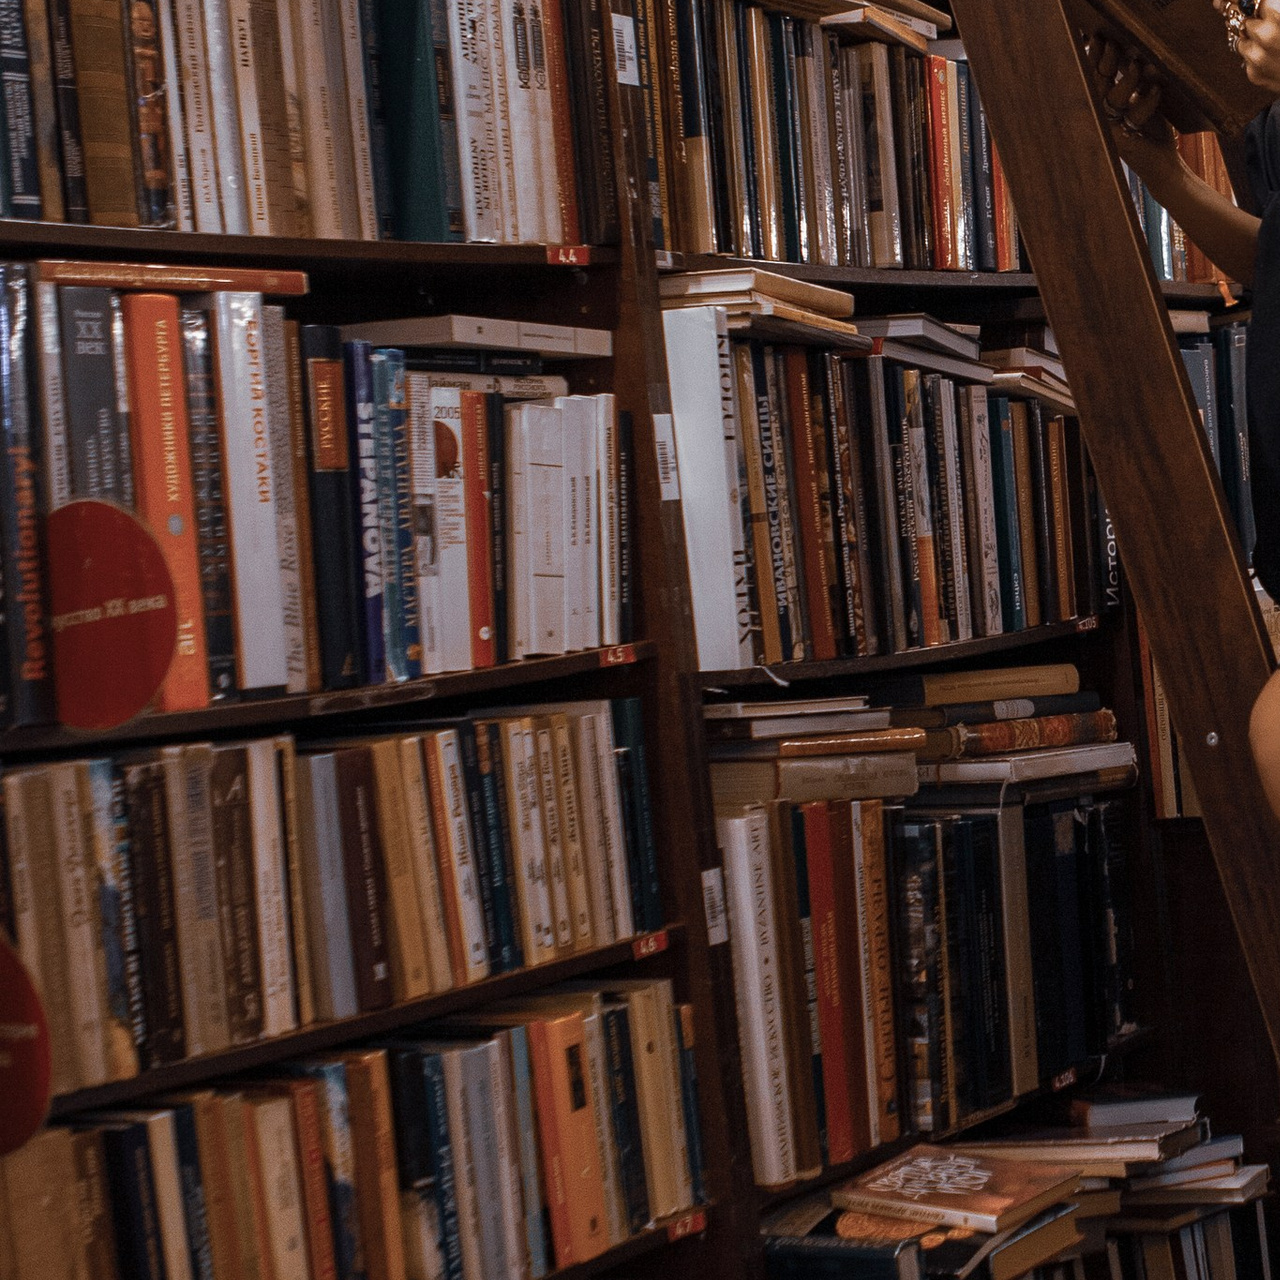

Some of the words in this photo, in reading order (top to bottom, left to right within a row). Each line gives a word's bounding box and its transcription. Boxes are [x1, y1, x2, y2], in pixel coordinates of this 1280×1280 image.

[236, 16, 250, 68] НАРБУТ
[188, 54, 205, 133] Голландский
[830, 68, 842, 108] TRAYS
[484, 120, 496, 162] АНРИ
[501, 126, 513, 170] АНРИ
[978, 113, 991, 173] Драгоценные
[477, 149, 489, 191] COLOR
[983, 185, 993, 208] Смит
[558, 249, 577, 263] 4.4
[150, 318, 173, 407] ПЕТЕРБУРГА
[243, 318, 262, 400] ЕОРГИЙ
[434, 405, 461, 419] 2005
[800, 372, 809, 409] COSTUME
[823, 369, 835, 411] костюм
[315, 380, 334, 448] РУССКИЕ
[757, 395, 775, 466] СИТЦЫ
[804, 411, 813, 448] CHUVASH
[159, 410, 182, 501] ХУДОЖНИКИ
[251, 406, 271, 503] КОСТАКИ
[828, 415, 841, 469] народный
[354, 401, 385, 598] STEPANOVA
[834, 473, 845, 515] Русский
[278, 524, 297, 574] Rose
[281, 582, 300, 629] Blue
[846, 589, 857, 636] Costume
[1009, 572, 1023, 610] НЭЦКЭ
[284, 638, 302, 675] The
[607, 648, 623, 662] 4.5
[748, 825, 761, 855] ART
[751, 863, 770, 947] BYZANTINE
[640, 937, 657, 953] 4.6
[762, 974, 780, 1060] ИСКУССТВО
